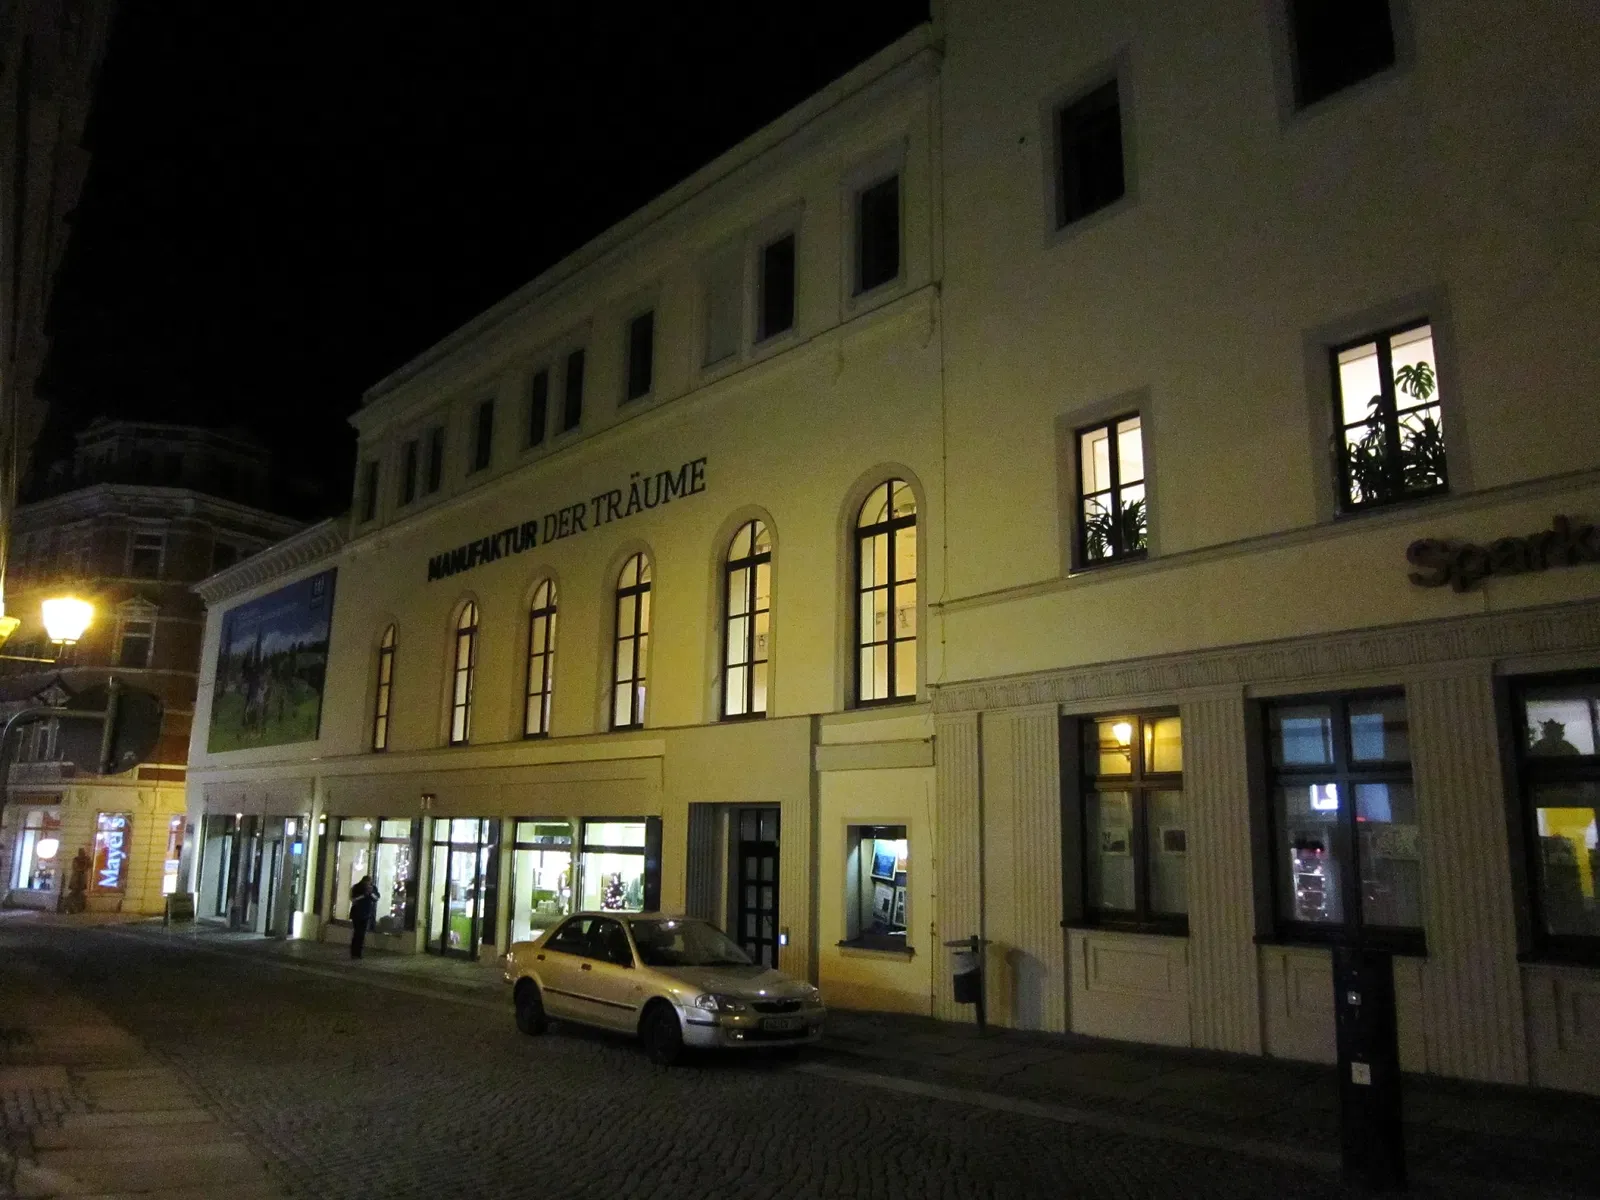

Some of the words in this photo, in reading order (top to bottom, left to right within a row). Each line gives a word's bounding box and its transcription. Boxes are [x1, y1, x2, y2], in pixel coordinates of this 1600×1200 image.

[428, 520, 538, 581] MANUFAKTUR
[542, 502, 589, 545] DER
[591, 457, 709, 528] TRÄUME
